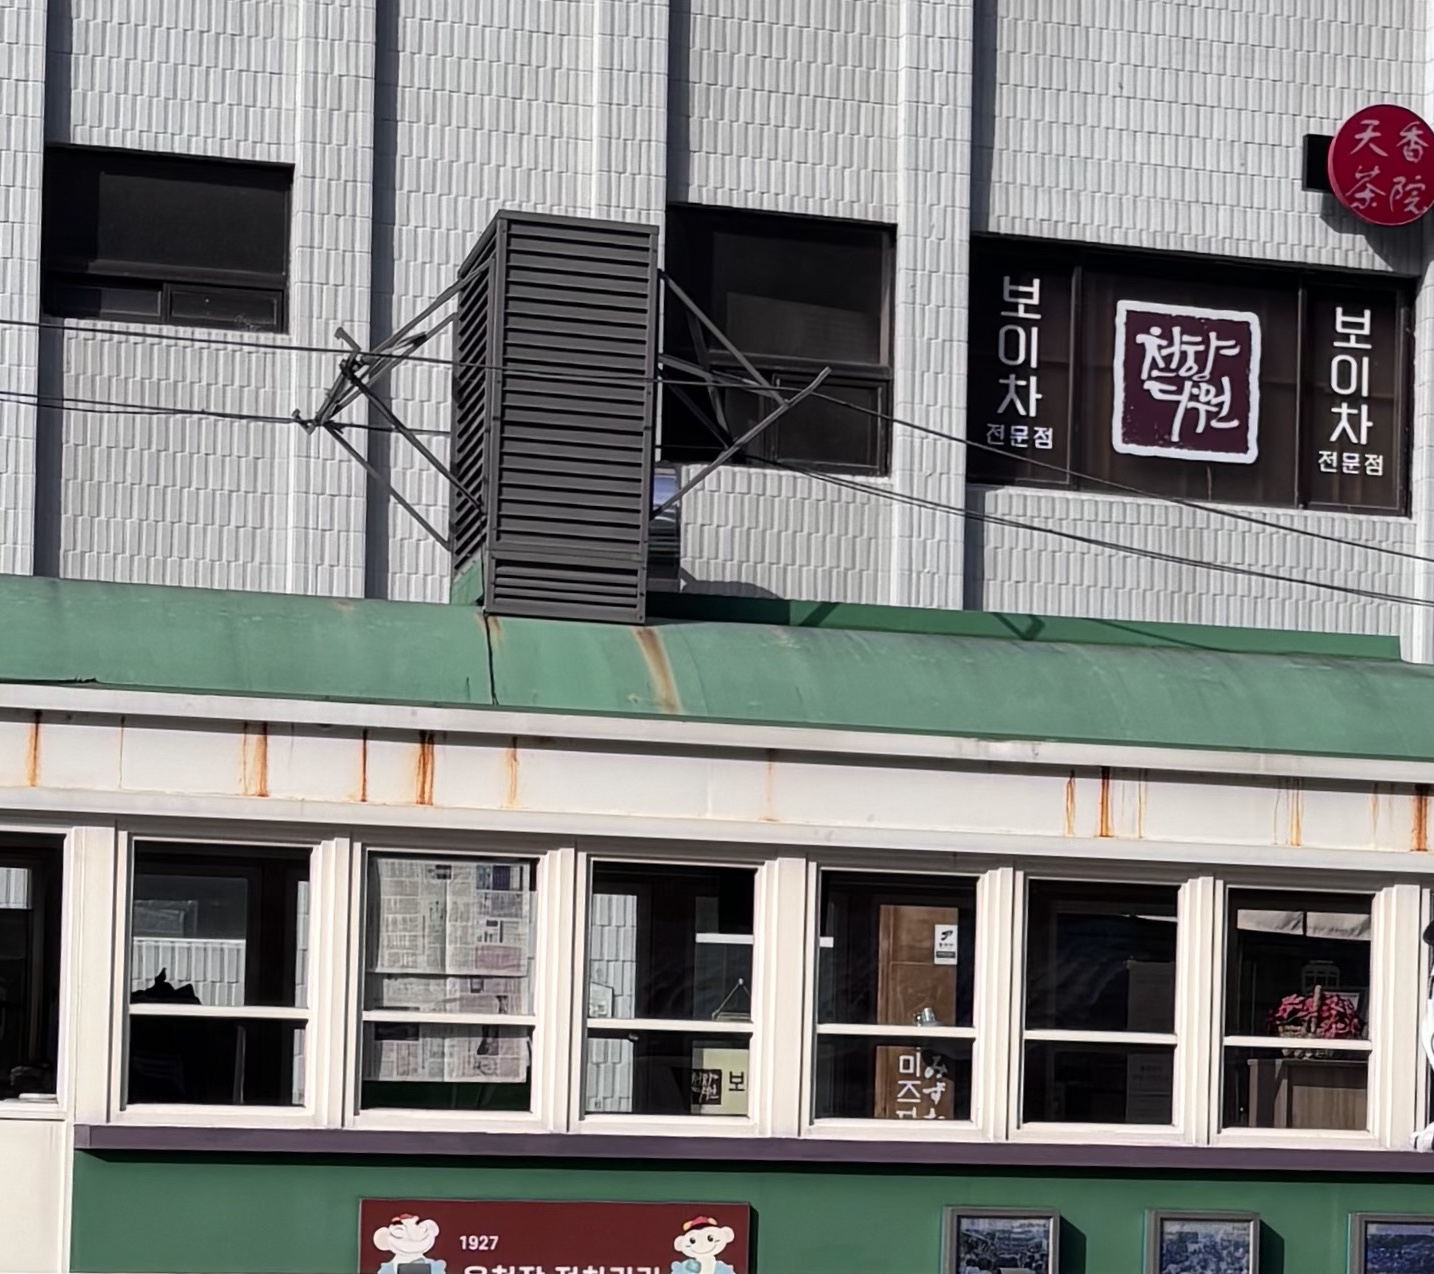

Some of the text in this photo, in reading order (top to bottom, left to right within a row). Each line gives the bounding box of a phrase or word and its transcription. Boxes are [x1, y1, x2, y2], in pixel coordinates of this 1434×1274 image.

[996, 276, 1043, 418] 보이차
[1330, 306, 1373, 446] 보이차
[985, 422, 1054, 451] 전문점
[1317, 451, 1384, 477] 전문점
[922, 1055, 949, 1120] みず
[459, 1234, 500, 1251] 1927
